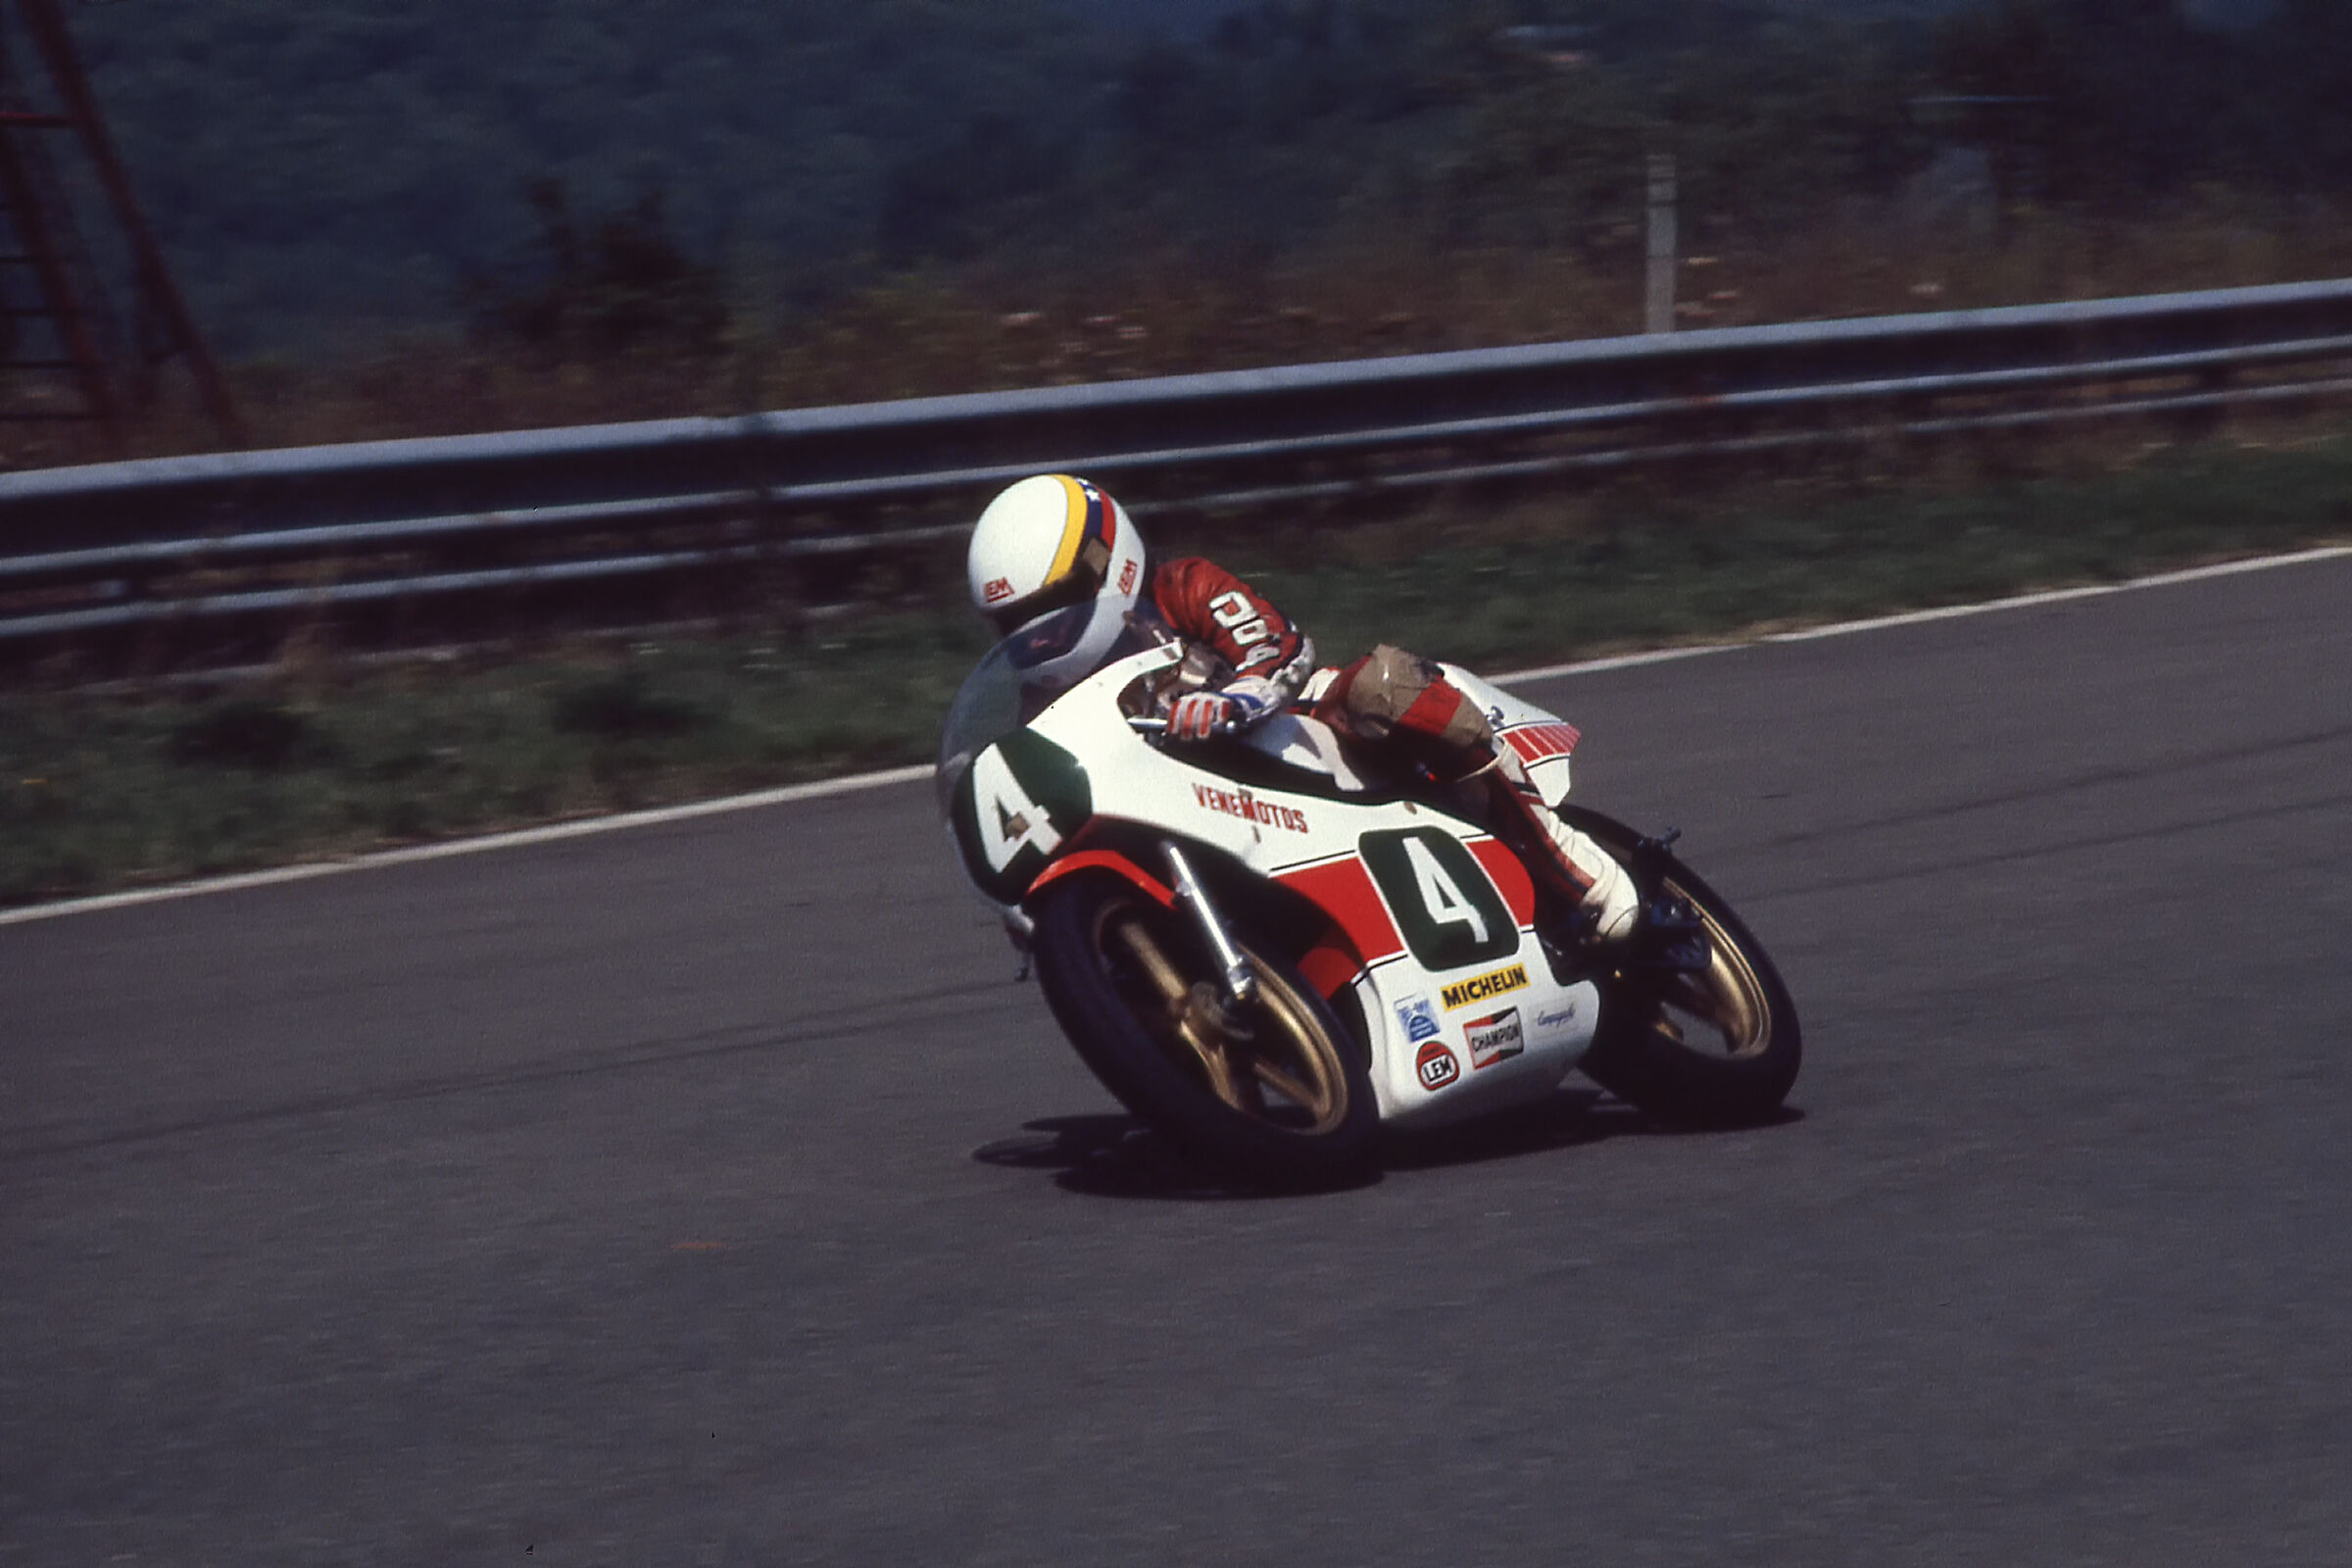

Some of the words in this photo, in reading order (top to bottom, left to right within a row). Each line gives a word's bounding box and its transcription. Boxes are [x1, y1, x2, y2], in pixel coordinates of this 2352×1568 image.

[972, 742, 1064, 873] 4
[1192, 782, 1308, 833] VENEMOTOS
[1401, 836, 1490, 944] 4
[1442, 966, 1527, 1008] MICHELIN
[1471, 1022, 1520, 1053] CHAMPION
[1423, 1055, 1453, 1082] LEM
